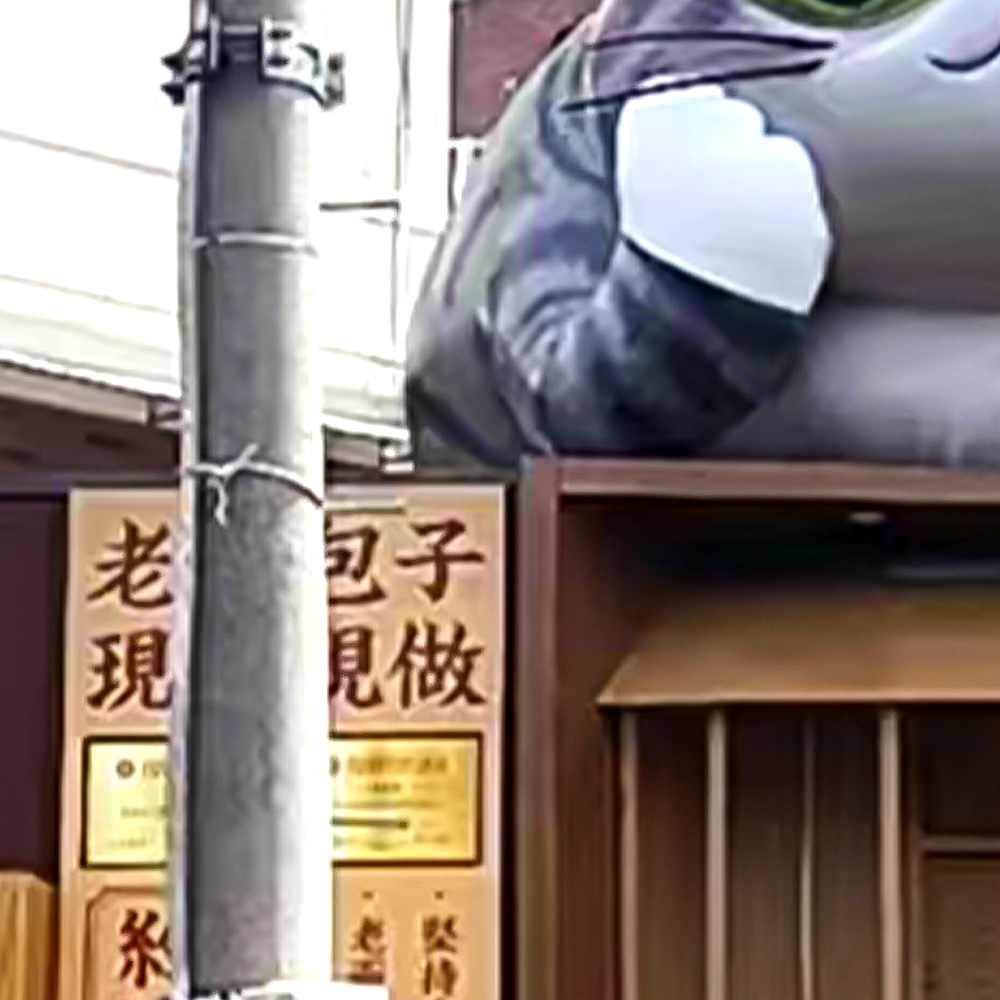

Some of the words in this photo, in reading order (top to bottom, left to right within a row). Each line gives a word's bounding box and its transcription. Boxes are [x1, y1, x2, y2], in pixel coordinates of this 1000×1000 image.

[87, 518, 484, 607] 老包子
[87, 620, 485, 711] 現現做
